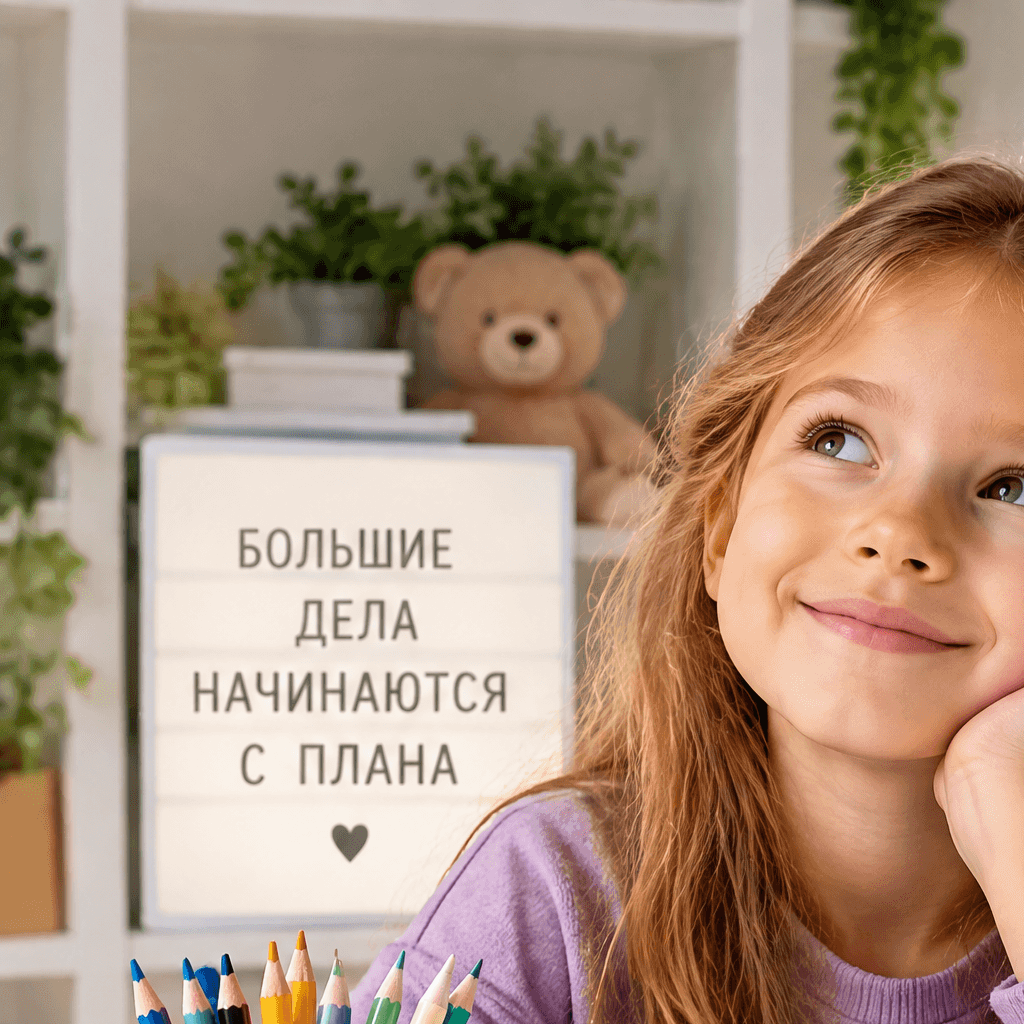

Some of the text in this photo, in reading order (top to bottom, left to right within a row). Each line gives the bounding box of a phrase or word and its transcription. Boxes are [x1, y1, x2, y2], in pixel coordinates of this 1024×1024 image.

[239, 528, 452, 570] БОЛЬШИЕ
[295, 599, 419, 648] ДЕЛА
[193, 671, 507, 713] НАЧИНАЮТСЯ
[240, 743, 458, 786] С ПЛАНА
